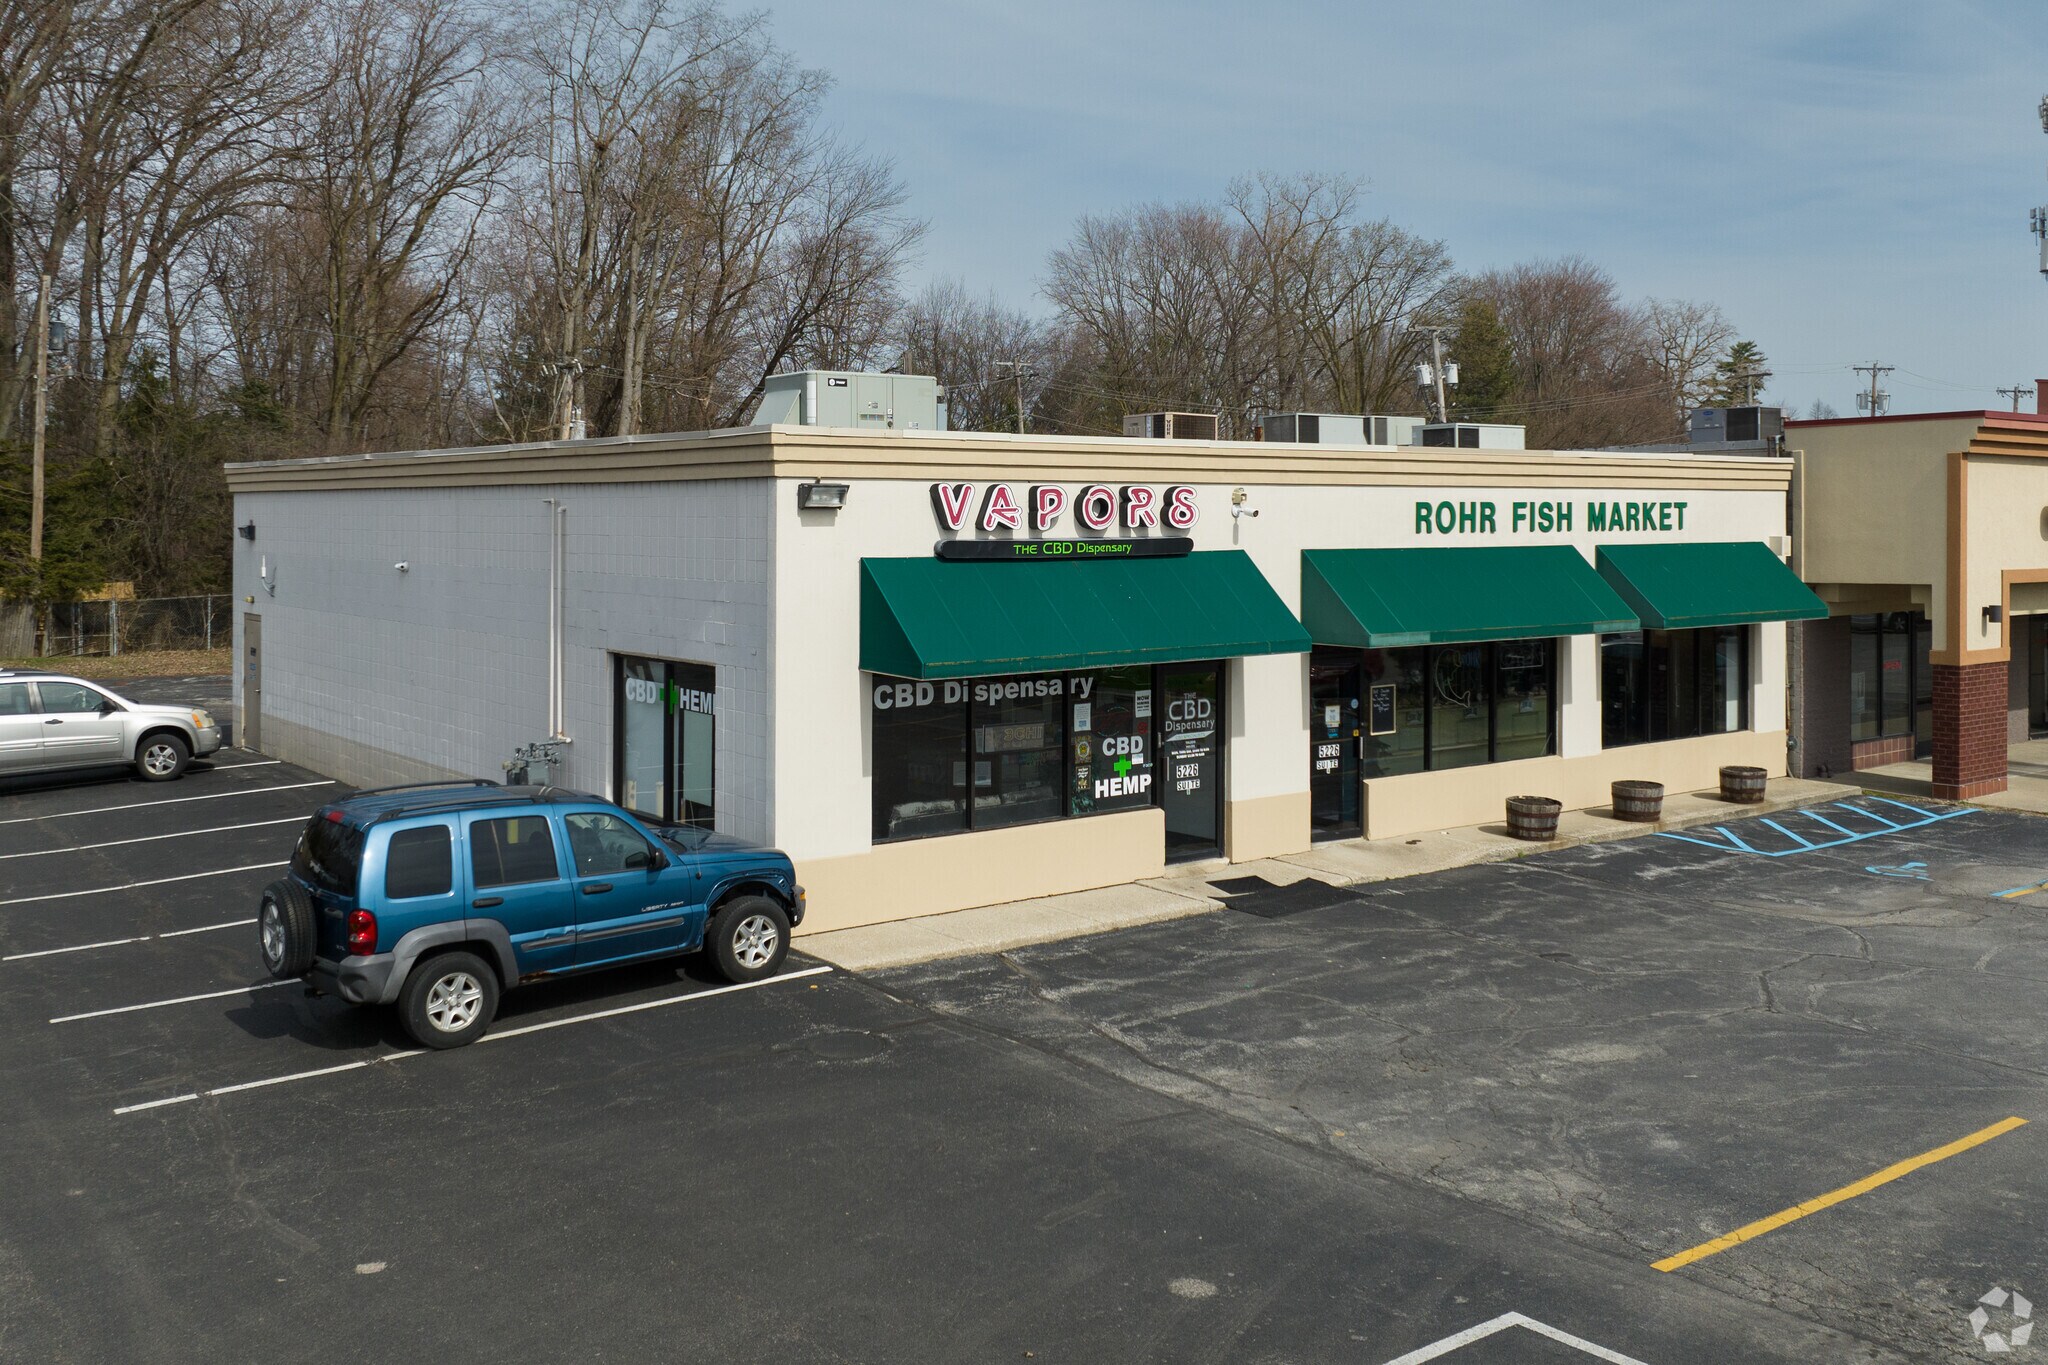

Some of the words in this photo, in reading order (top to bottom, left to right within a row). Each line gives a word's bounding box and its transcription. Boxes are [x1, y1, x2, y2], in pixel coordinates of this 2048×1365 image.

[929, 483, 1200, 531] VAPORS
[1415, 501, 1496, 534] ROHR
[1512, 502, 1573, 533] FISH
[1587, 502, 1688, 532] MARKET
[1013, 544, 1038, 555] THE
[1042, 542, 1073, 555] CBD
[1076, 542, 1132, 555] Dispensary
[626, 677, 657, 704] CBD
[680, 687, 716, 714] HEM
[873, 683, 935, 710] CBD
[1168, 698, 1211, 721] CBD
[1165, 719, 1215, 732] Dispensary
[1102, 735, 1144, 757] CBD
[1319, 744, 1340, 758] 5226
[1177, 764, 1199, 779] 5226
[1316, 759, 1338, 770] SUITE
[1094, 773, 1152, 799] HEMP
[1176, 779, 1200, 791] SUITE
